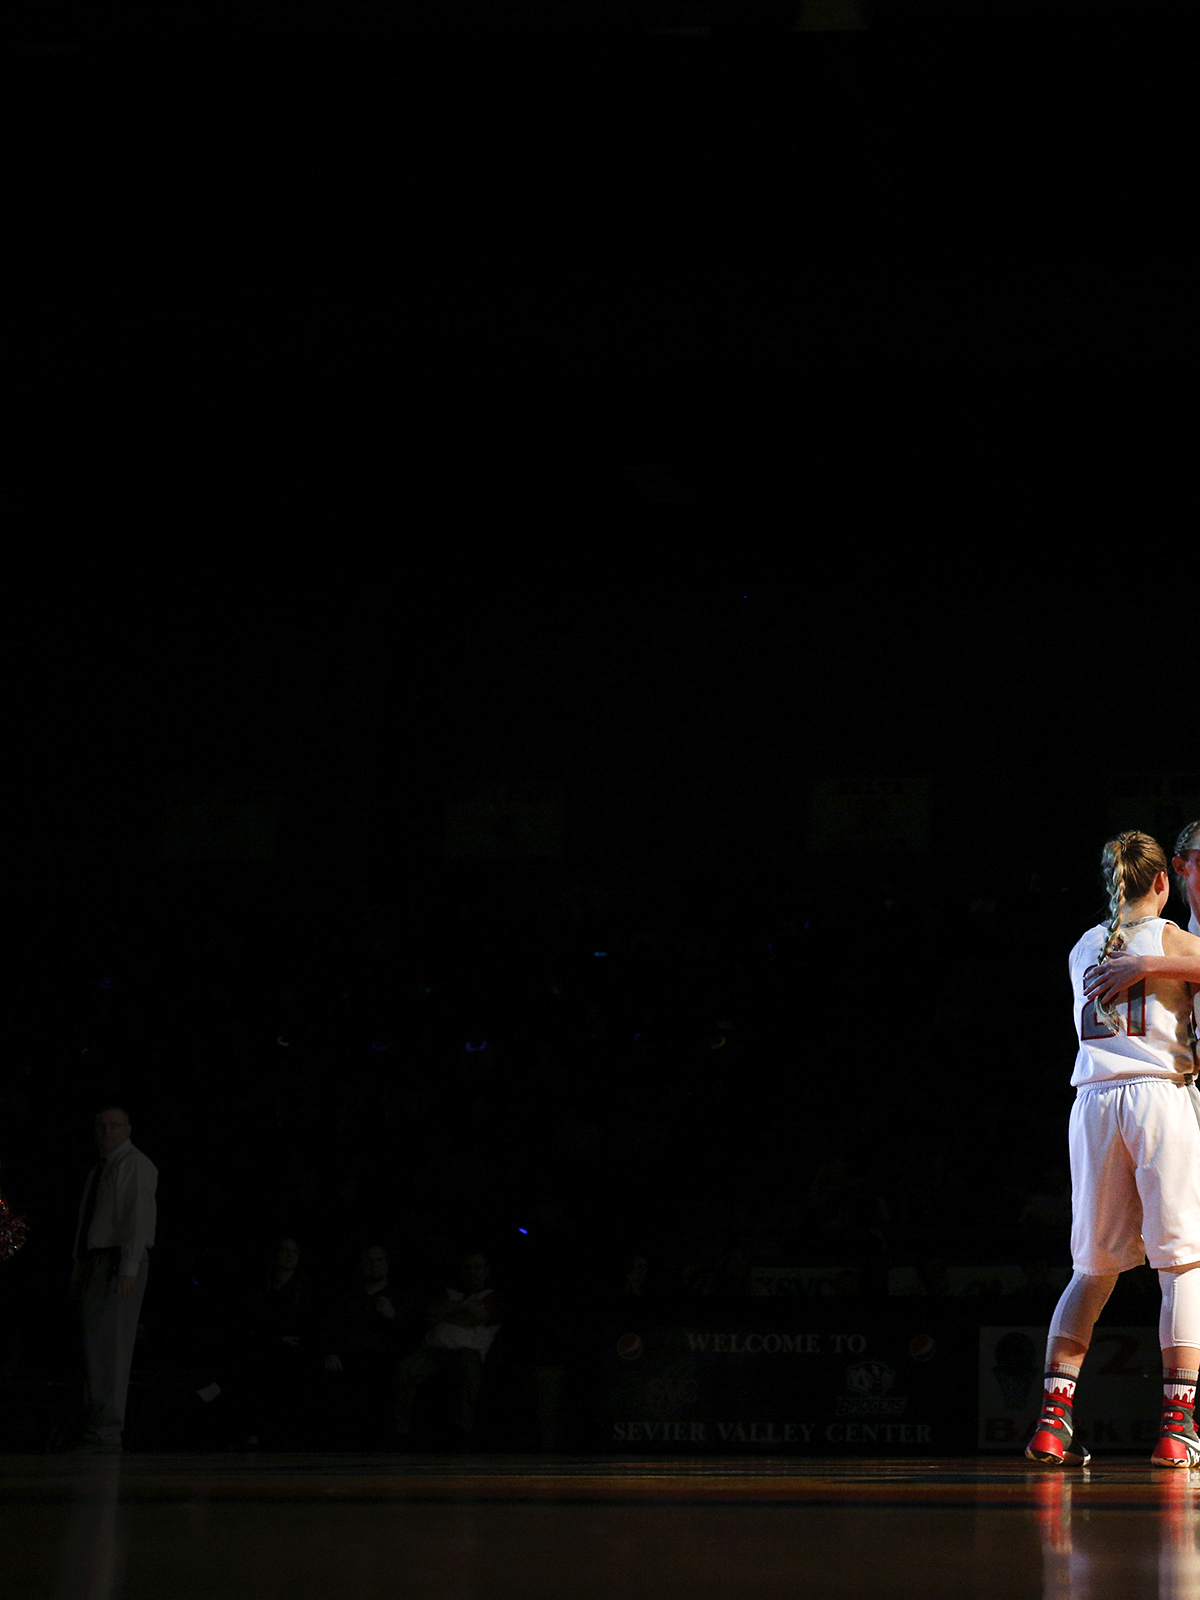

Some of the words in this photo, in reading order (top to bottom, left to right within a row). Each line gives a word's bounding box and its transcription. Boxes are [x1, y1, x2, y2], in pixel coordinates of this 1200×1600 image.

[686, 1333, 821, 1354] WELCOME
[829, 1333, 867, 1354] TO
[612, 1421, 706, 1442] SEVIER
[716, 1421, 816, 1444] VALLEY
[825, 1422, 932, 1444] CENTER
